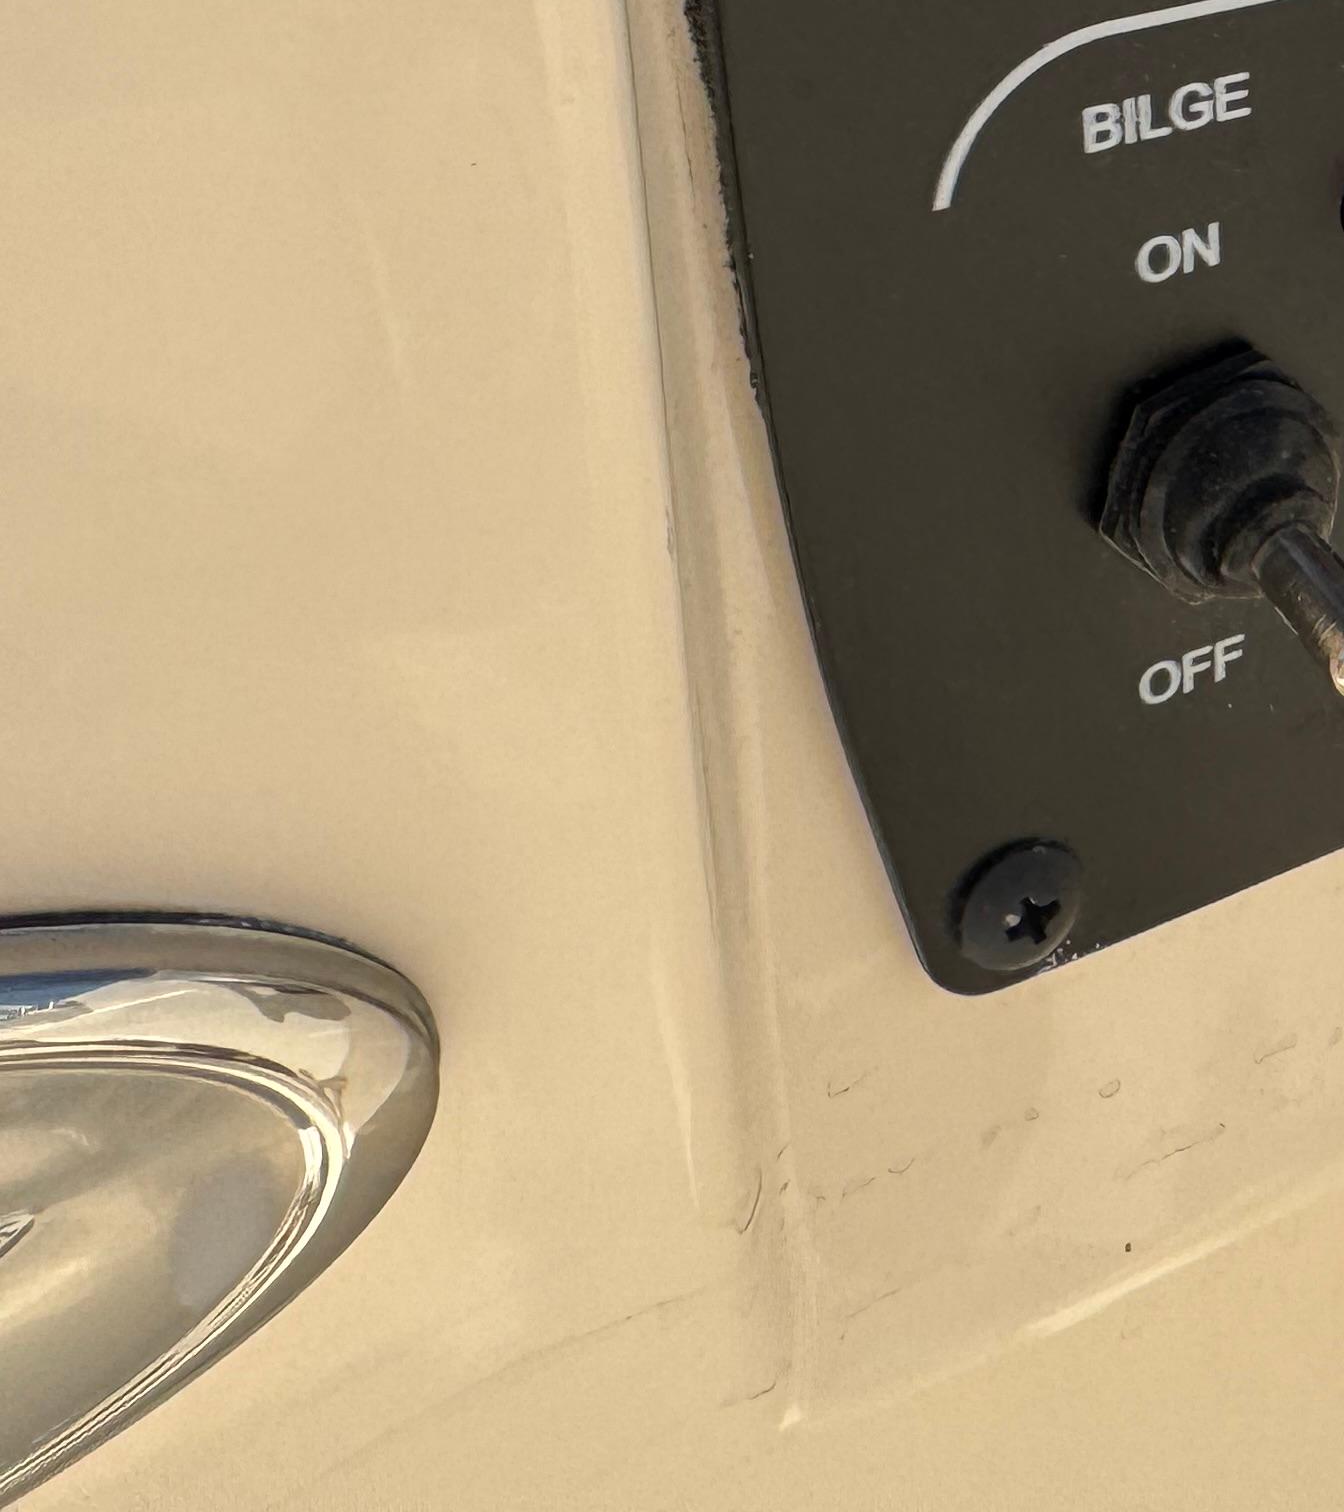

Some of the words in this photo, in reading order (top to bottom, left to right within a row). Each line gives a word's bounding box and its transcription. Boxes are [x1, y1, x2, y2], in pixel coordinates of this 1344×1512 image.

[1081, 71, 1252, 154] BILGE
[1134, 221, 1221, 284] ON
[1138, 633, 1246, 705] OFF
